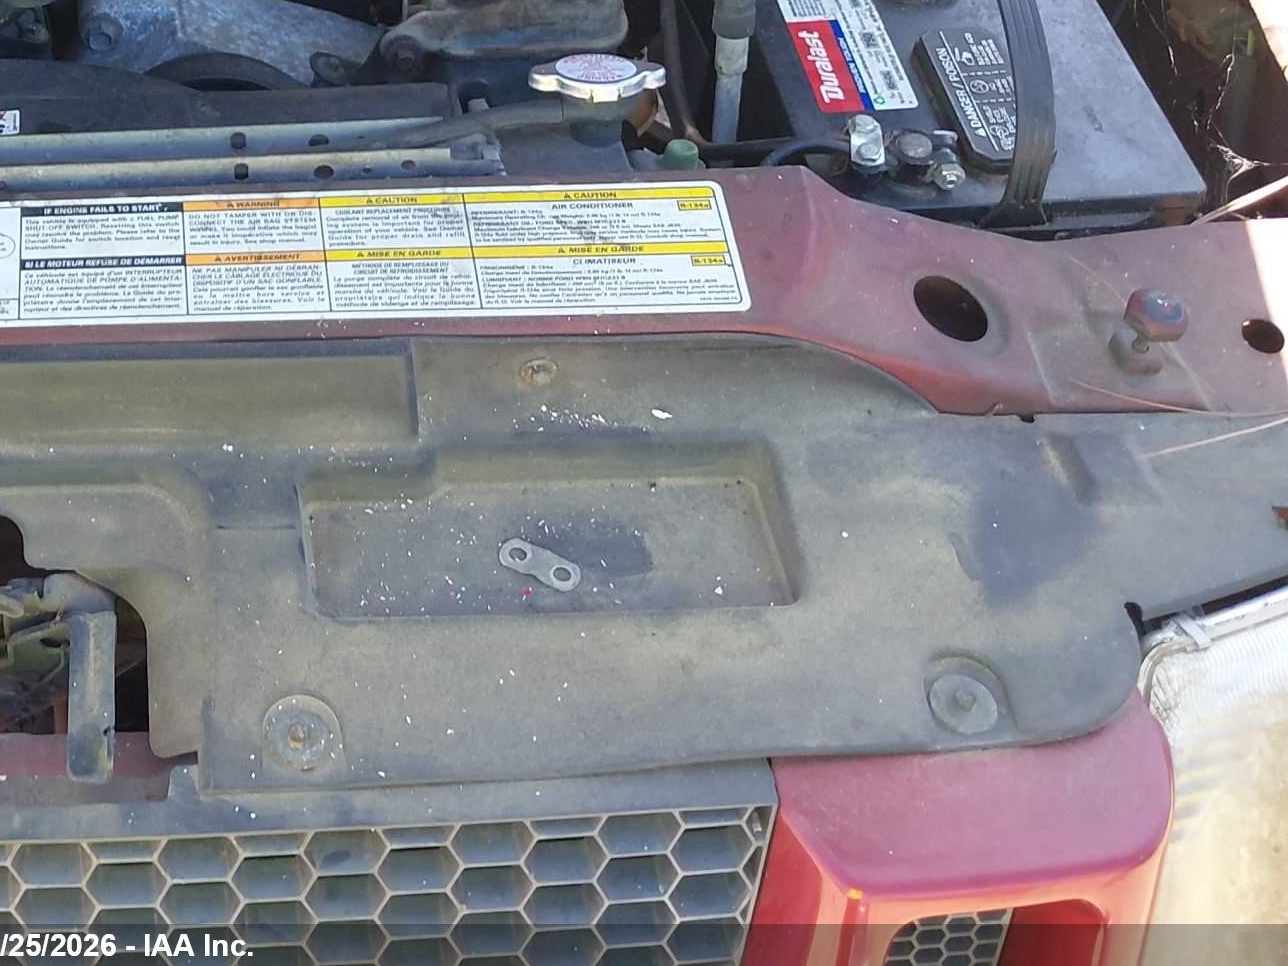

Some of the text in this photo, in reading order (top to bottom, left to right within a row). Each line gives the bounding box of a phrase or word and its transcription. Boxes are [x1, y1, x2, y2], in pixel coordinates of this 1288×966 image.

[798, 30, 845, 104] Duralast
[935, 47, 960, 81] POISON
[956, 89, 982, 128] DANGER
[570, 191, 617, 199] CAUTION
[34, 260, 44, 268] LE
[46, 259, 84, 267] MOTEUR
[85, 258, 116, 266] REFUSE
